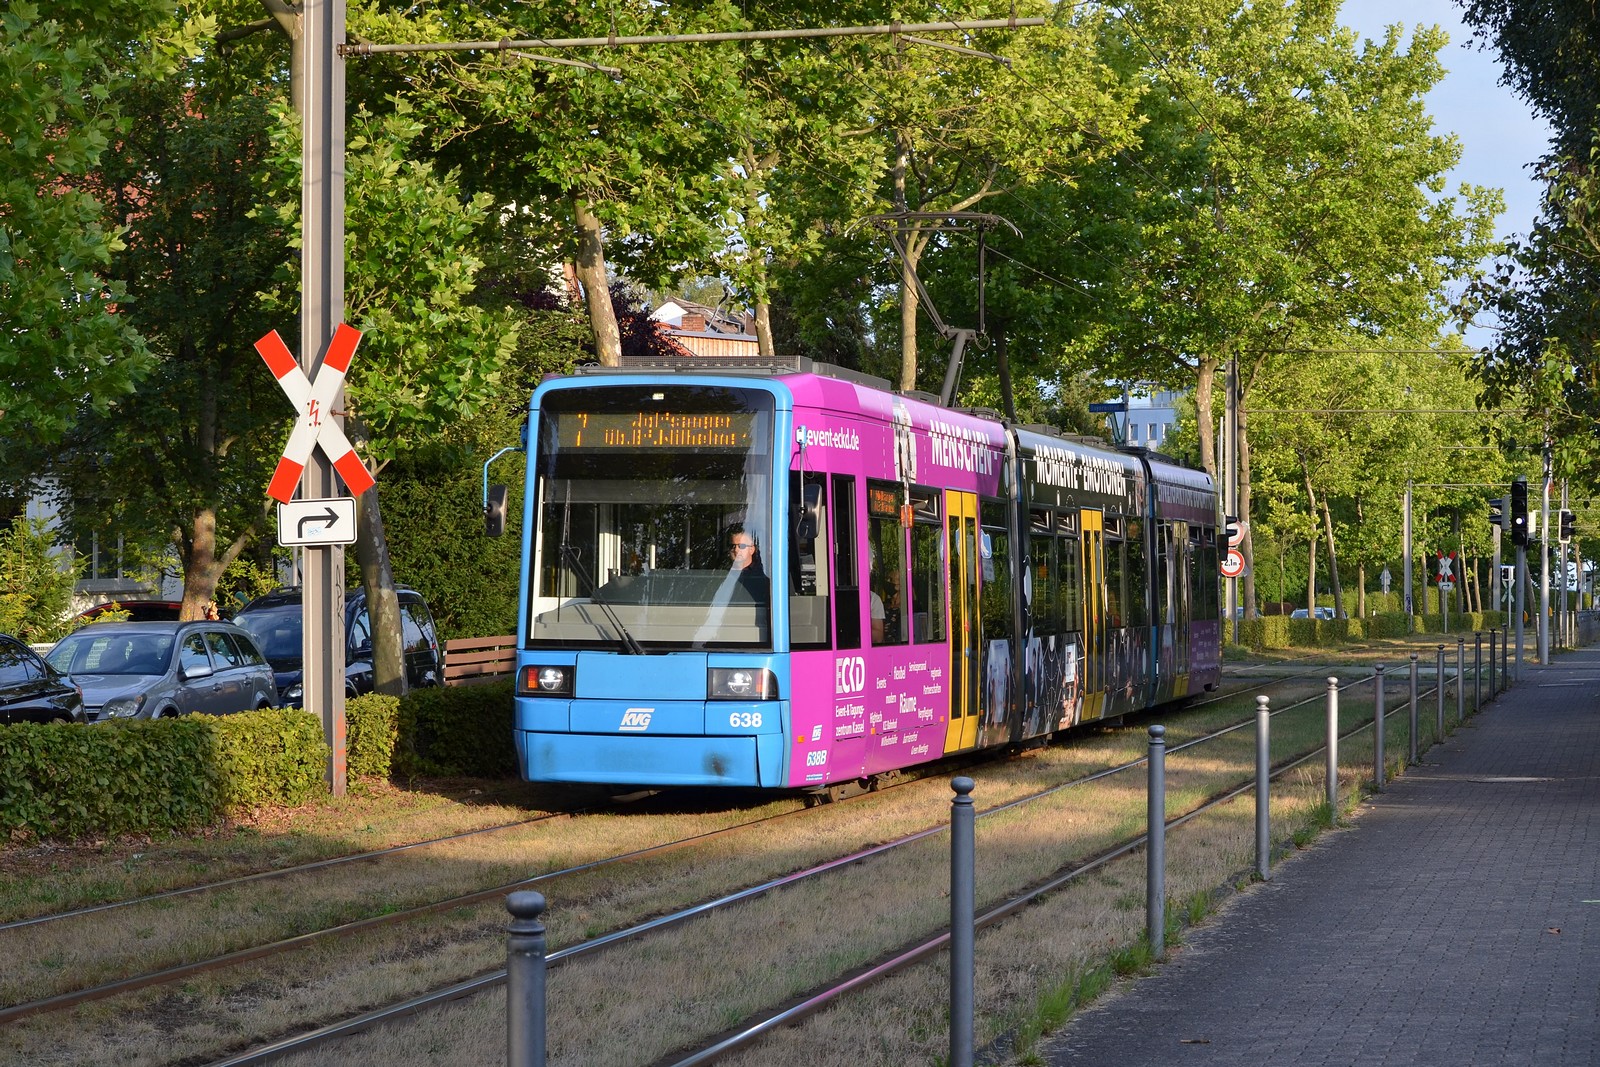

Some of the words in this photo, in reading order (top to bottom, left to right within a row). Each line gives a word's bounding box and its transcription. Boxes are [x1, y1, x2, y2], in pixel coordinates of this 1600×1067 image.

[928, 420, 991, 475] MENSCHEN
[1034, 444, 1077, 489] MOMENTE
[1080, 454, 1126, 496] EMOTIONEN
[620, 711, 652, 728] KVG
[730, 713, 761, 727] 638
[806, 750, 827, 766] 638B
